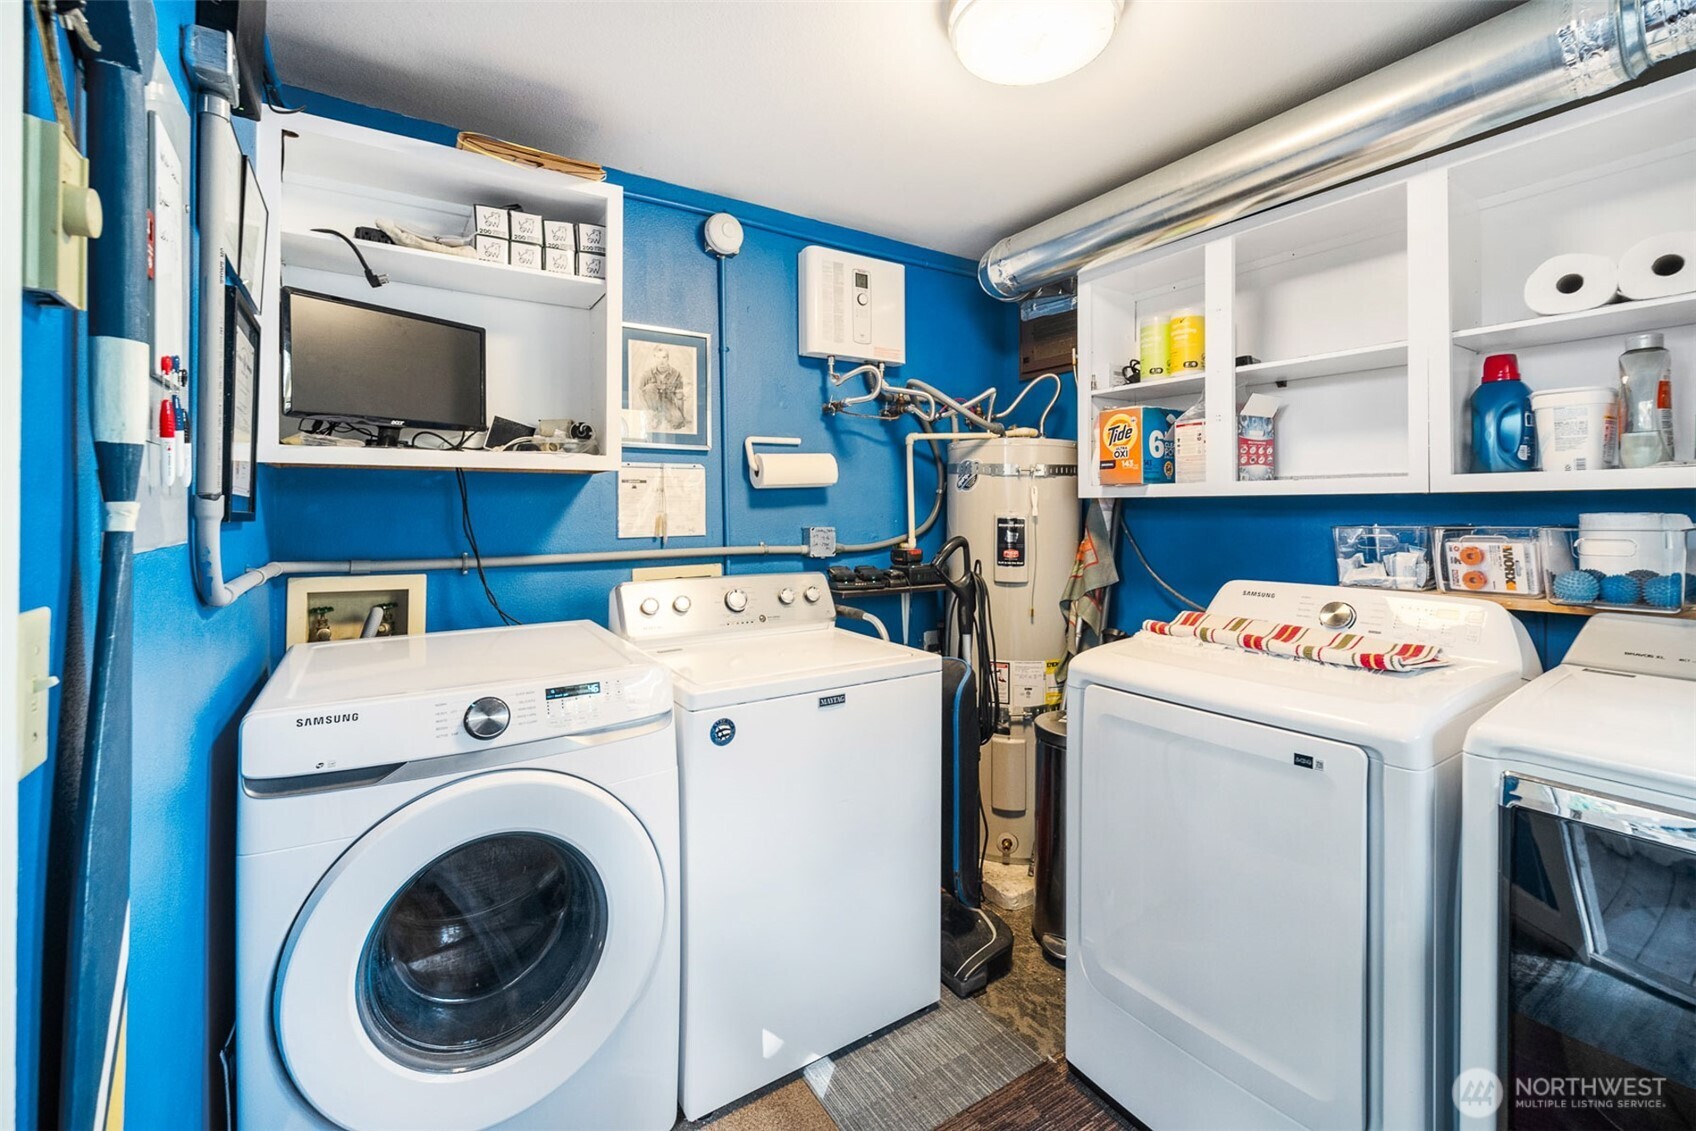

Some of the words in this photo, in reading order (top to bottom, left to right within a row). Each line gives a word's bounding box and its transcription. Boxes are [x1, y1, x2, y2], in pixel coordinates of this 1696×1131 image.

[1108, 425, 1133, 446] Tide
[1149, 430, 1165, 458] 6
[1114, 450, 1128, 458] OXI
[1502, 548, 1517, 585] WORX
[1242, 590, 1276, 599] SAMSUNG
[820, 695, 845, 706] MAYTAG
[296, 712, 359, 728] SAMSUNG
